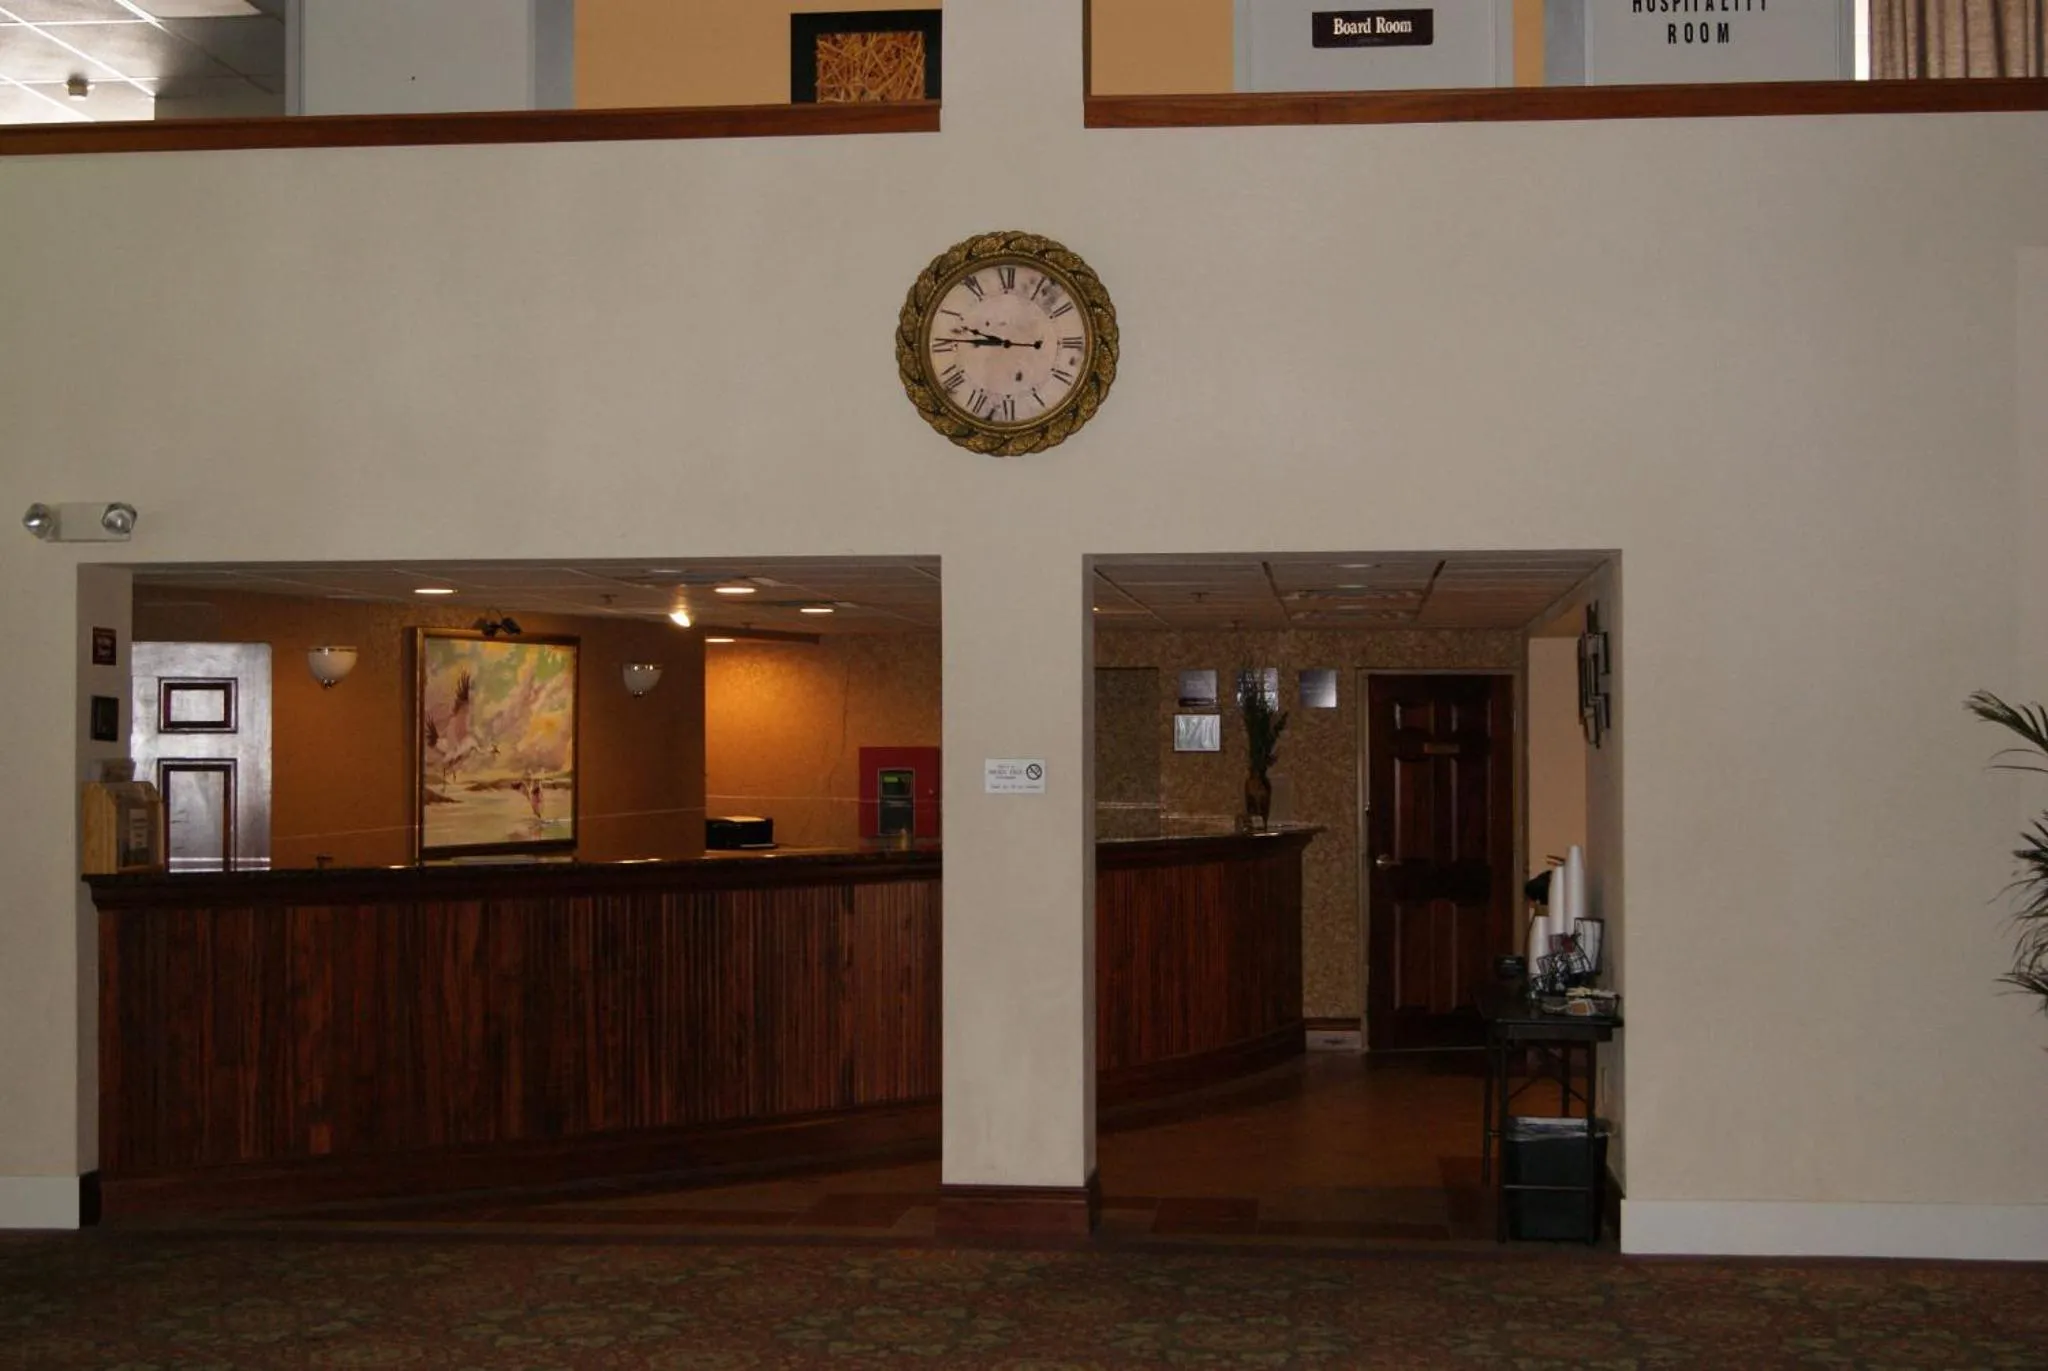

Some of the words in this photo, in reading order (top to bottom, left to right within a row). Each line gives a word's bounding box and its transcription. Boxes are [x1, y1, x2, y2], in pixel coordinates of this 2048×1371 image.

[1333, 18, 1371, 35] Board
[1376, 16, 1413, 33] Room
[1667, 22, 1730, 44] ROOM
